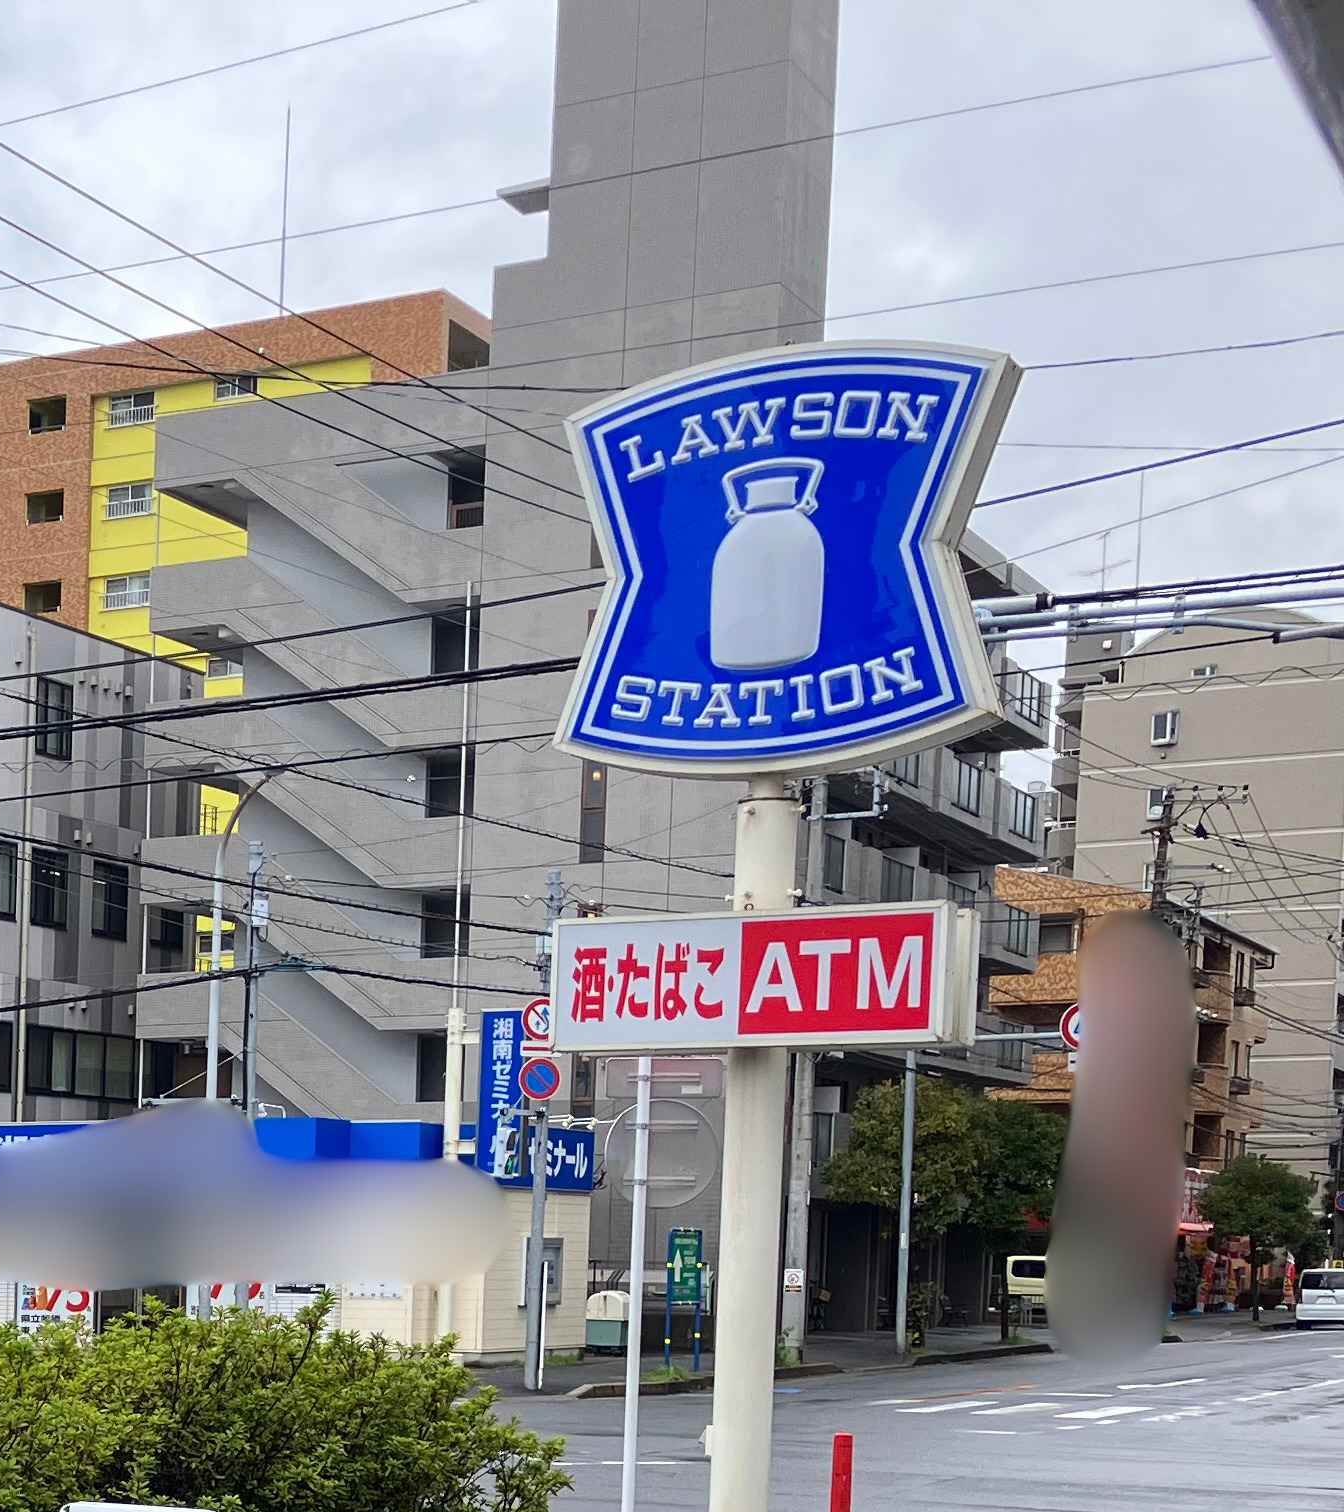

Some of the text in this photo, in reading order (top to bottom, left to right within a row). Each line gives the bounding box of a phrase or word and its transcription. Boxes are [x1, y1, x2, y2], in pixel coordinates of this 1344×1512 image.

[618, 389, 940, 484] LAWSON
[609, 646, 925, 729] STATION
[744, 934, 925, 1015] ATM
[489, 1017, 514, 1154] 湘南ゼミナ
